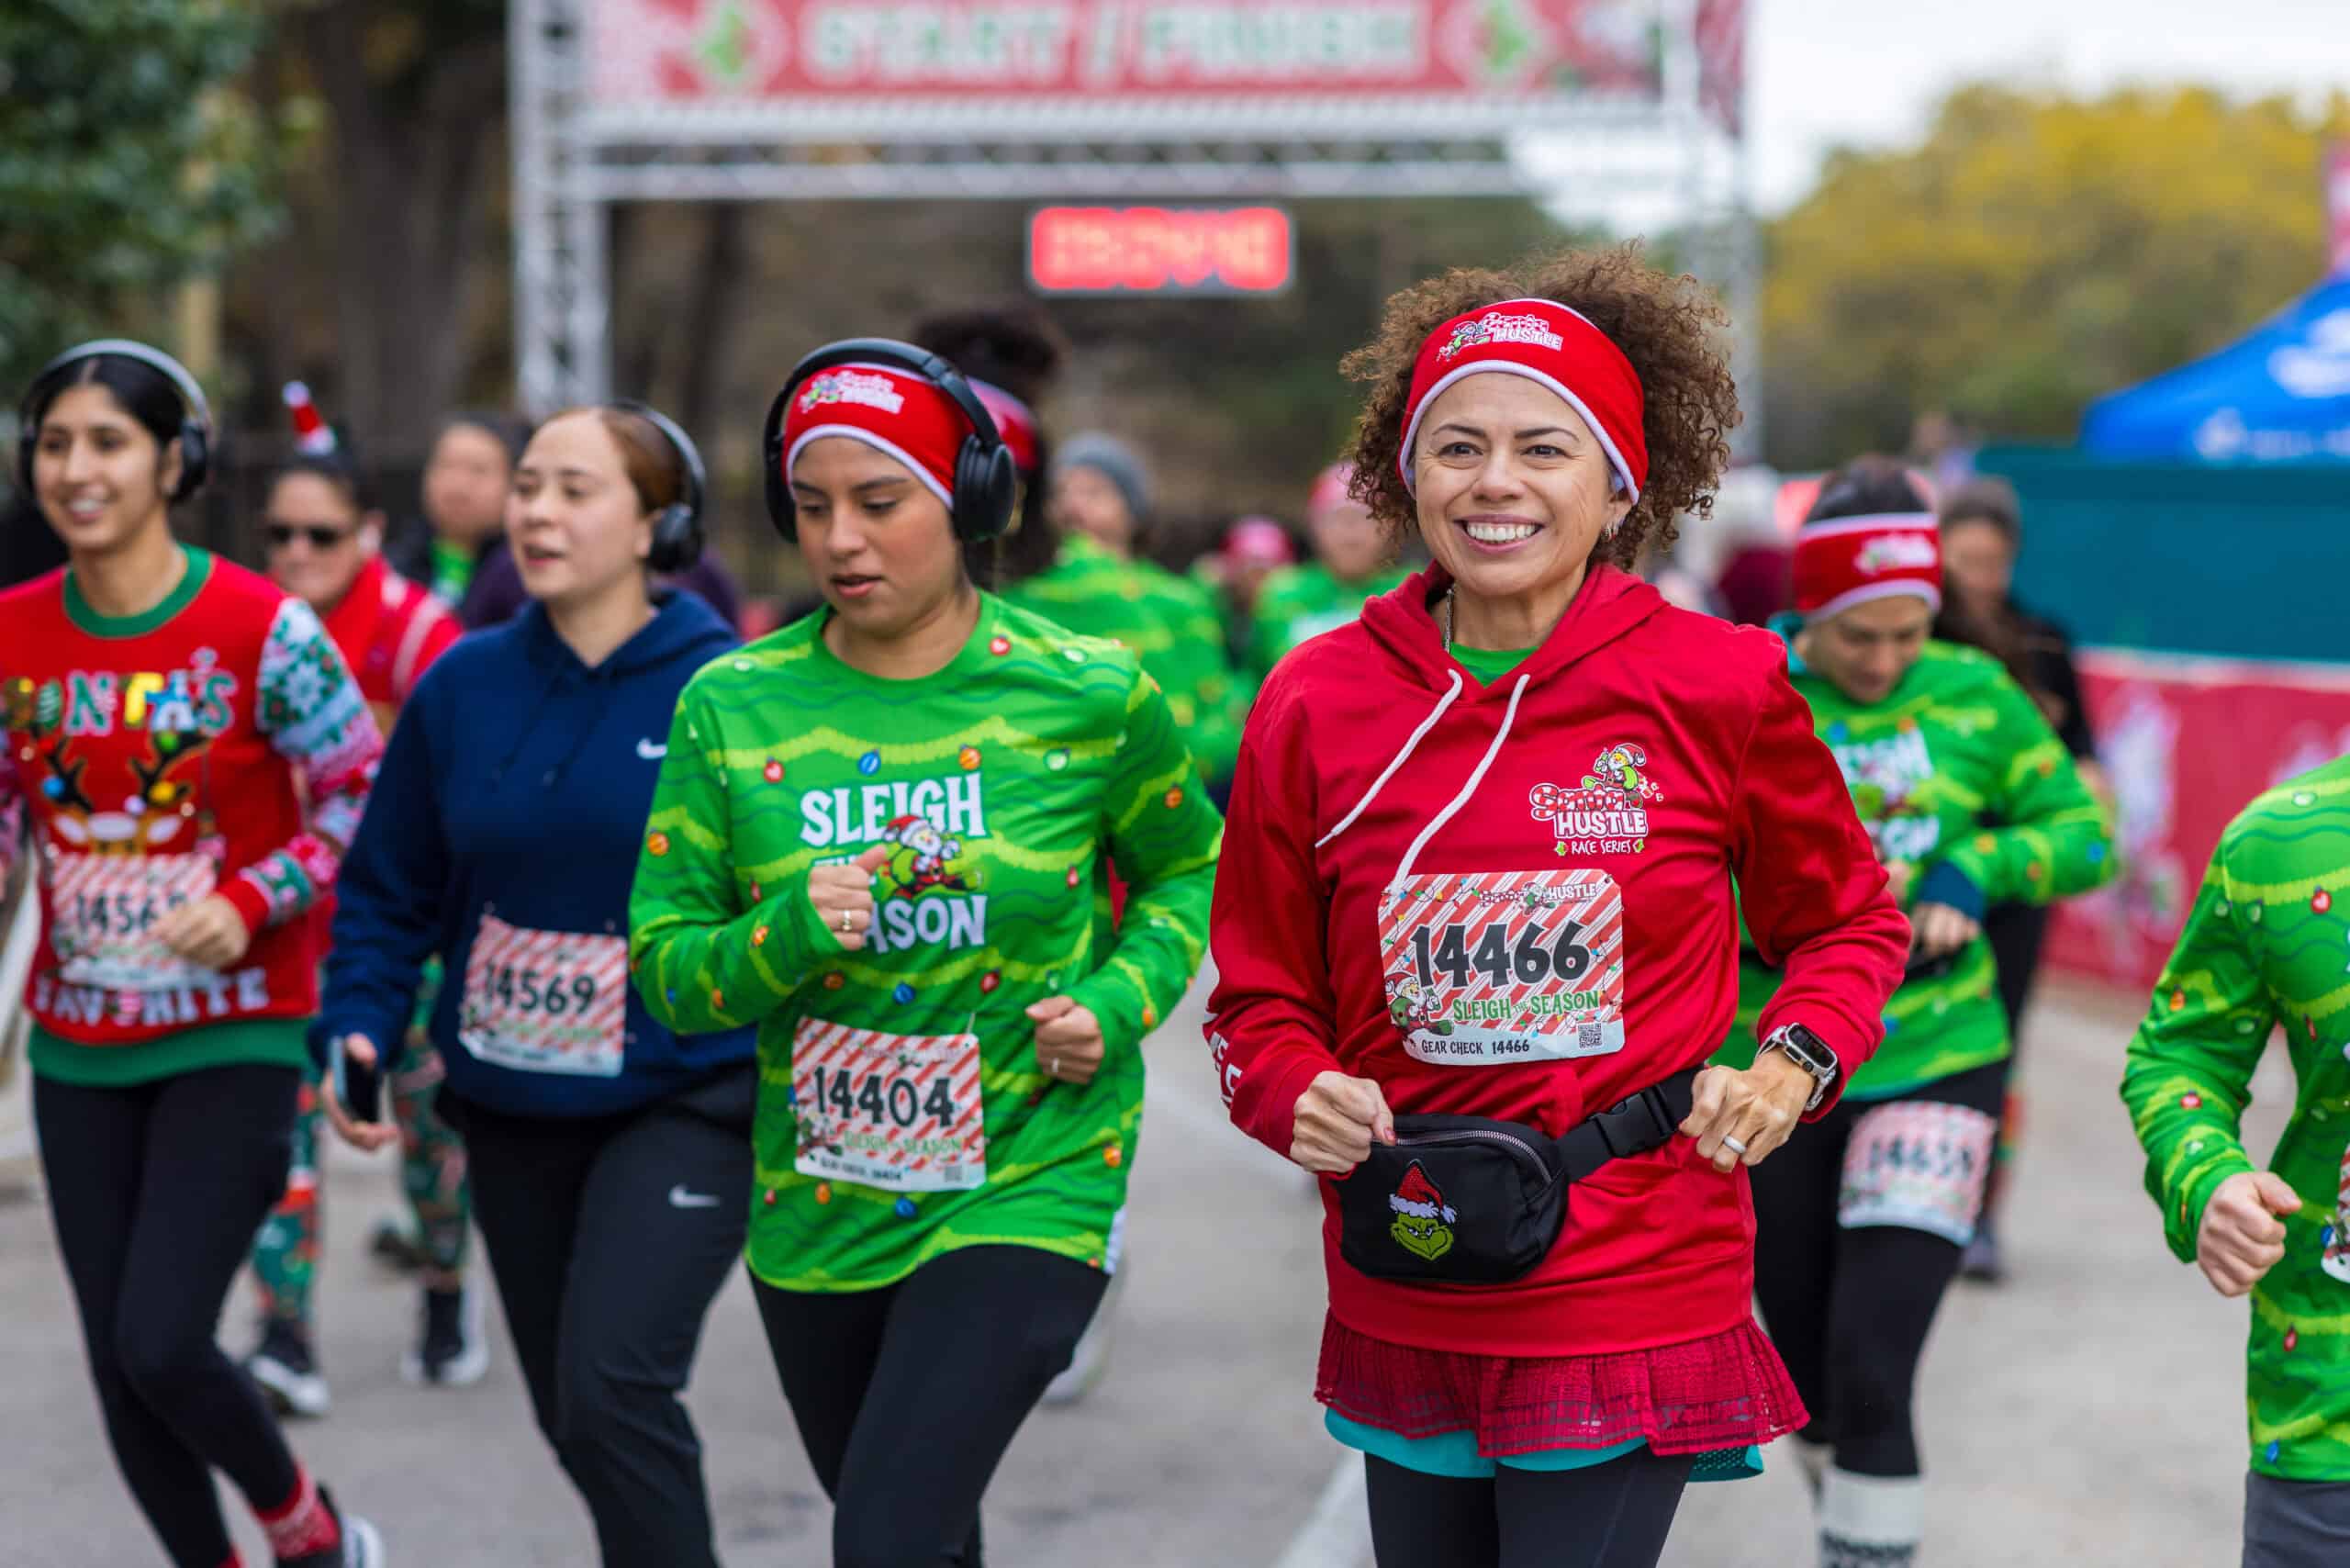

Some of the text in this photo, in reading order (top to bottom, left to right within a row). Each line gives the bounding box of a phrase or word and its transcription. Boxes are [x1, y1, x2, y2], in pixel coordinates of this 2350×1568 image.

[811, 4, 1066, 72] START
[1136, 6, 1425, 72] FINISH
[1492, 329, 1563, 351] HUSTLE
[3, 645, 238, 737] NTA'S
[800, 772, 987, 846] SLEIGH
[1555, 811, 1648, 836] HUSTLE
[1571, 839, 1631, 855] RACE SERIES
[75, 891, 188, 935] 1456
[1547, 882, 1598, 900] HUSTLE
[863, 894, 989, 954] ASON
[1409, 919, 1591, 988] 14466
[486, 958, 596, 1014] 14569
[1452, 998, 1513, 1021] SLEIGH
[1530, 990, 1600, 1014] SEASON
[1421, 1038, 1530, 1055] GEAR CHECK 14466
[814, 1065, 956, 1127] 14404
